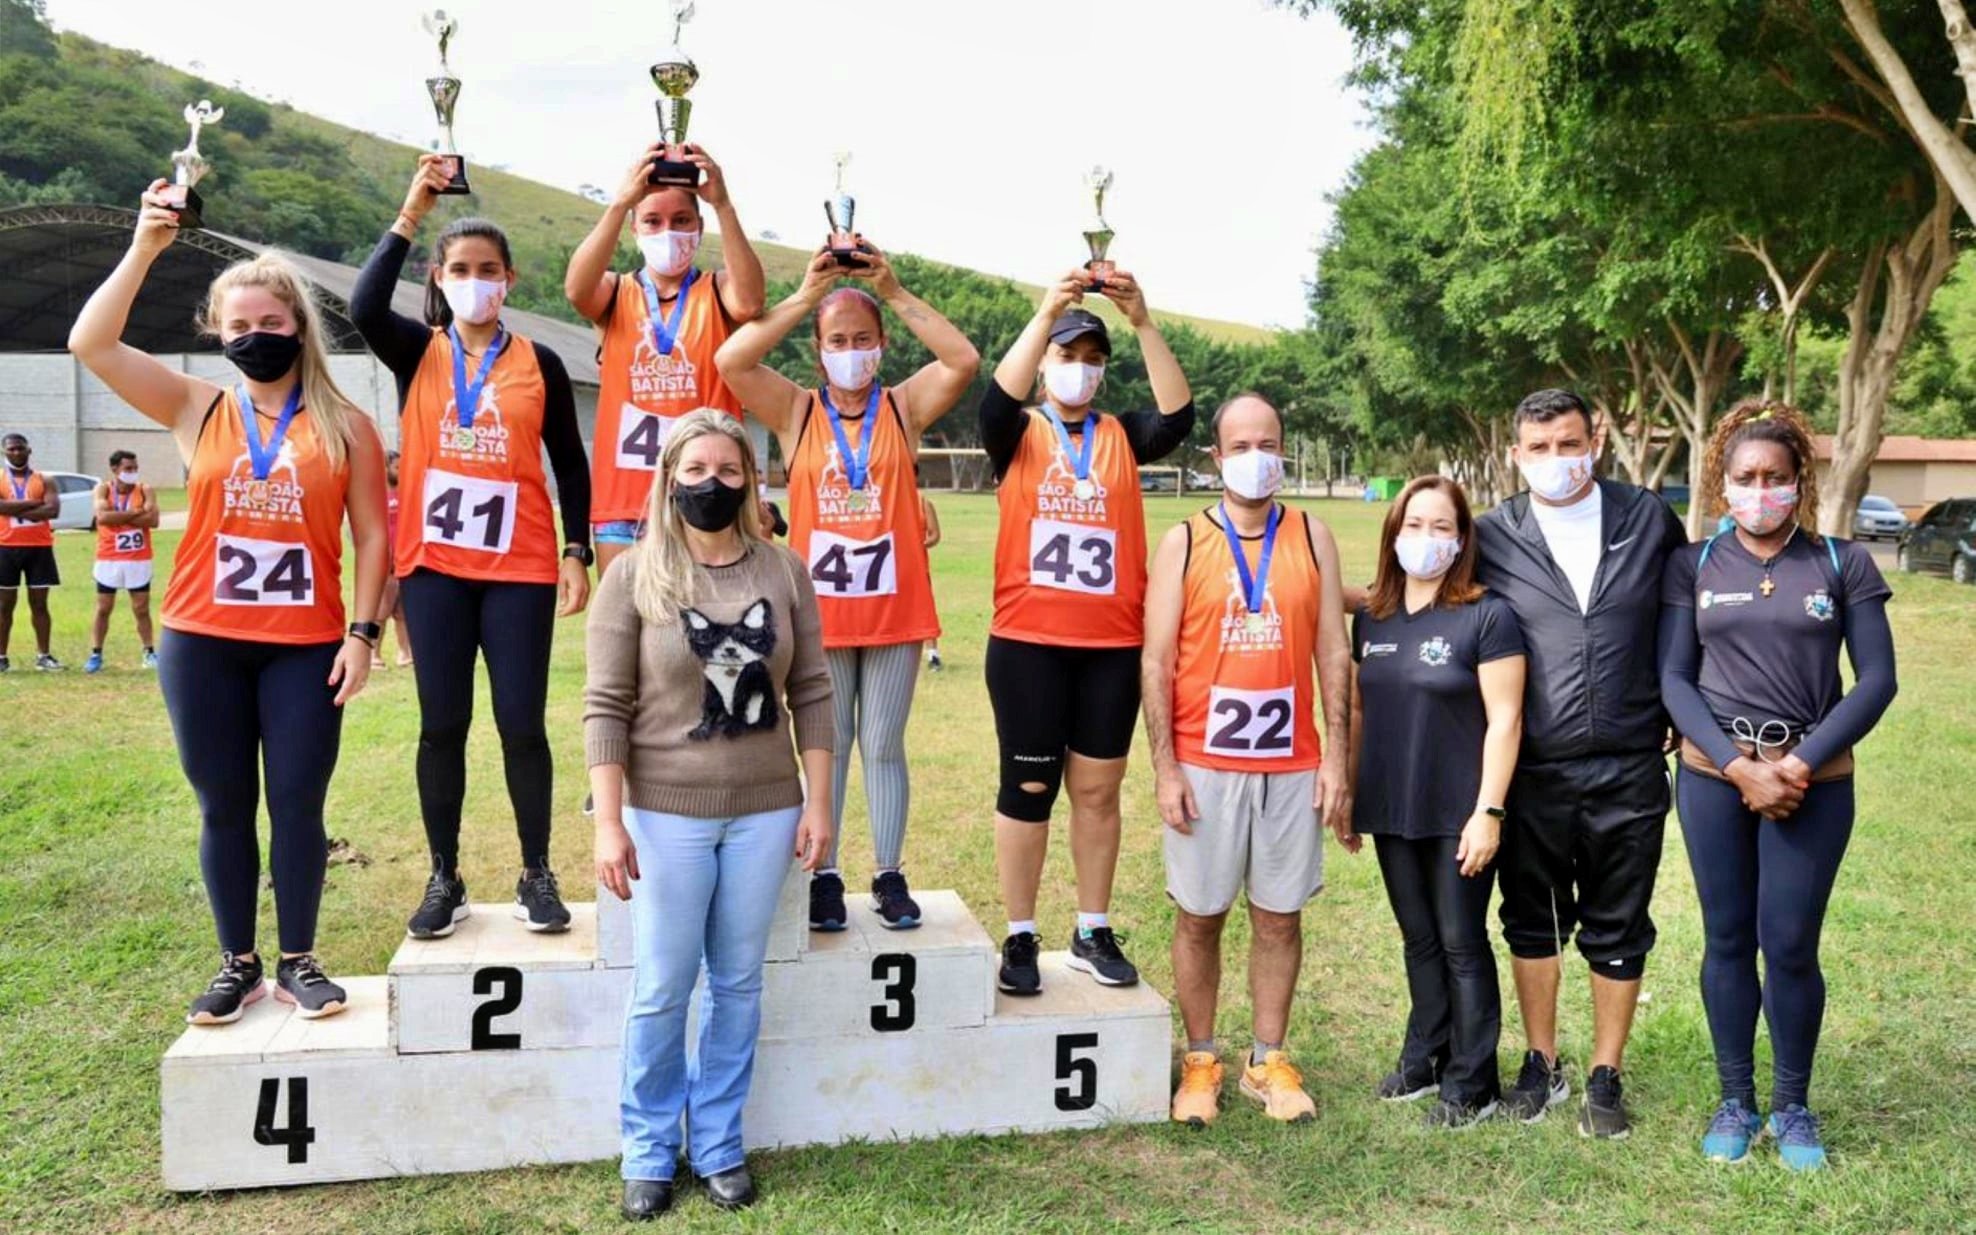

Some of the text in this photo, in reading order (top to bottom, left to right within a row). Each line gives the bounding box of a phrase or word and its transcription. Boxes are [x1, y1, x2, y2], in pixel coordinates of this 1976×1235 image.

[631, 375, 697, 393] BATISTA
[439, 432, 507, 455] BASTA
[622, 415, 661, 466] 4
[224, 491, 303, 516] BASTA
[426, 487, 506, 548] 41
[819, 498, 882, 514] BATTA
[1038, 496, 1106, 516] BATISTA
[117, 532, 145, 550] 29
[812, 539, 891, 592] 47
[1032, 533, 1113, 588] 43
[219, 545, 312, 601] 24
[1210, 699, 1292, 750] 22
[471, 966, 523, 1052] 2
[870, 952, 917, 1034] 3
[1054, 1032, 1099, 1112] 5
[253, 1076, 316, 1164] 4
